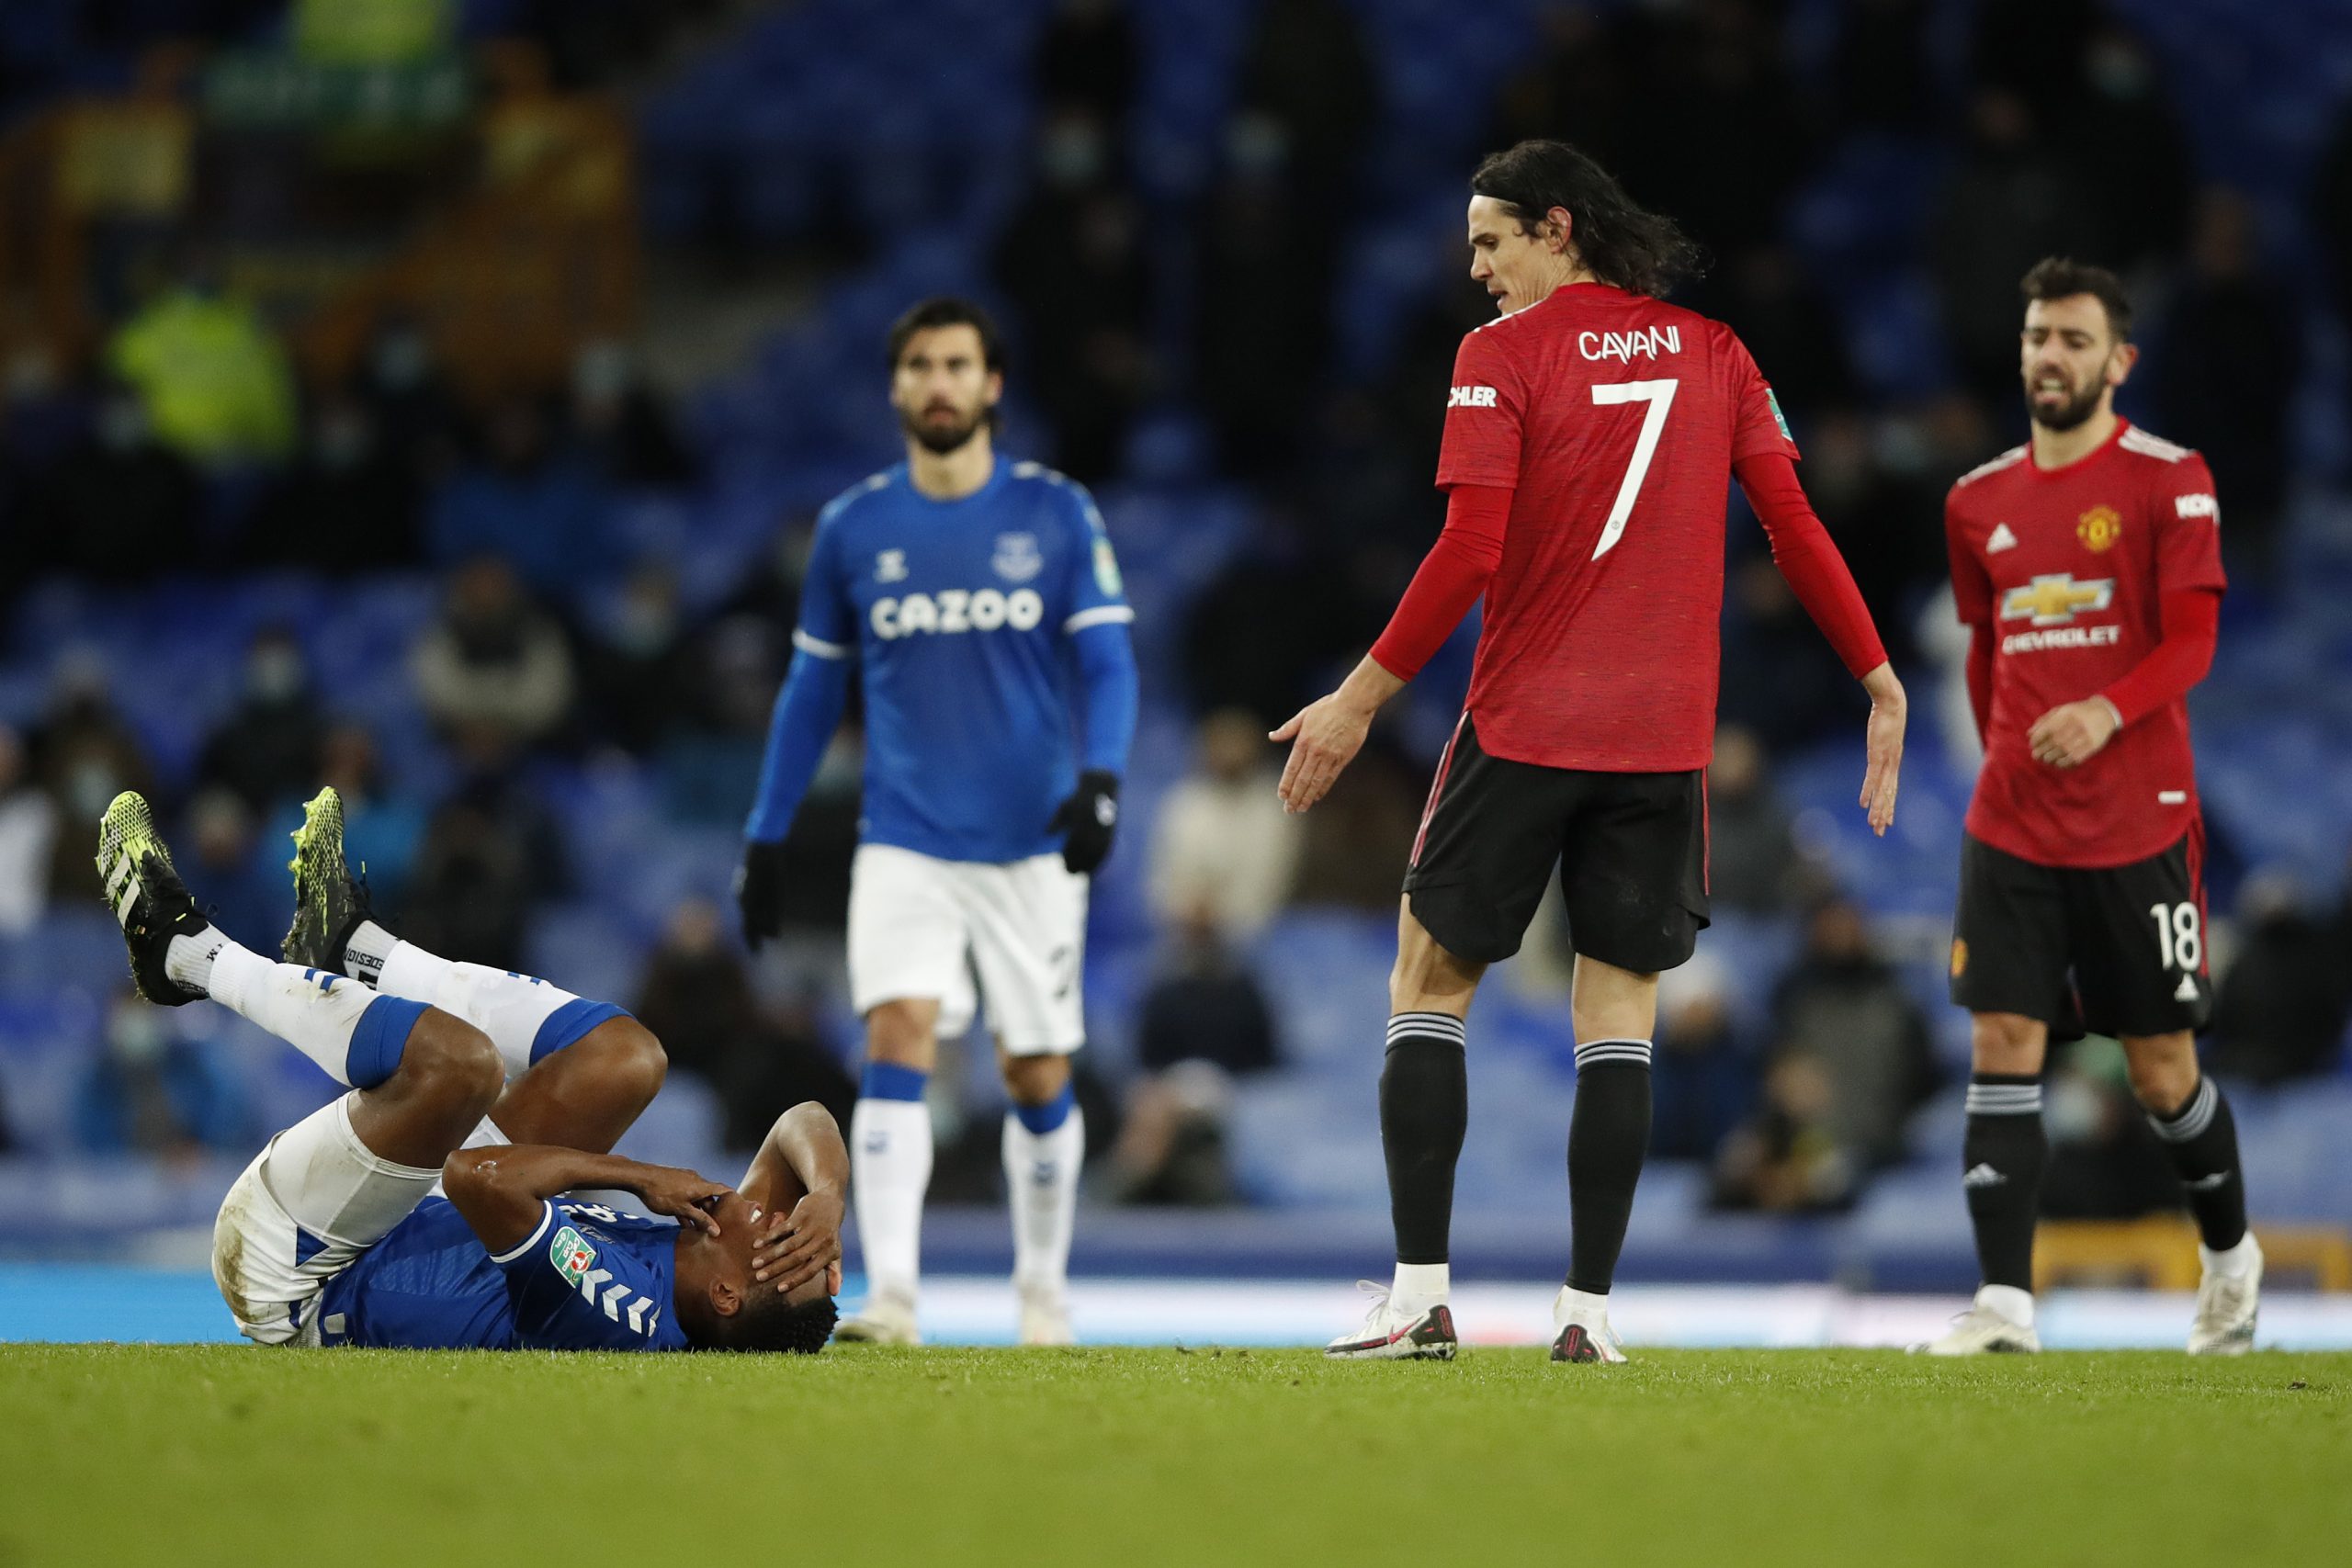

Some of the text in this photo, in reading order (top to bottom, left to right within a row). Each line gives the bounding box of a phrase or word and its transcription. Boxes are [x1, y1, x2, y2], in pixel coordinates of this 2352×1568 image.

[1578, 325, 1681, 366] CAVANI
[1590, 378, 1679, 562] 7
[870, 588, 1044, 640] CAZOO
[2002, 625, 2120, 655] CHEVROLET
[2150, 902, 2201, 972] 18
